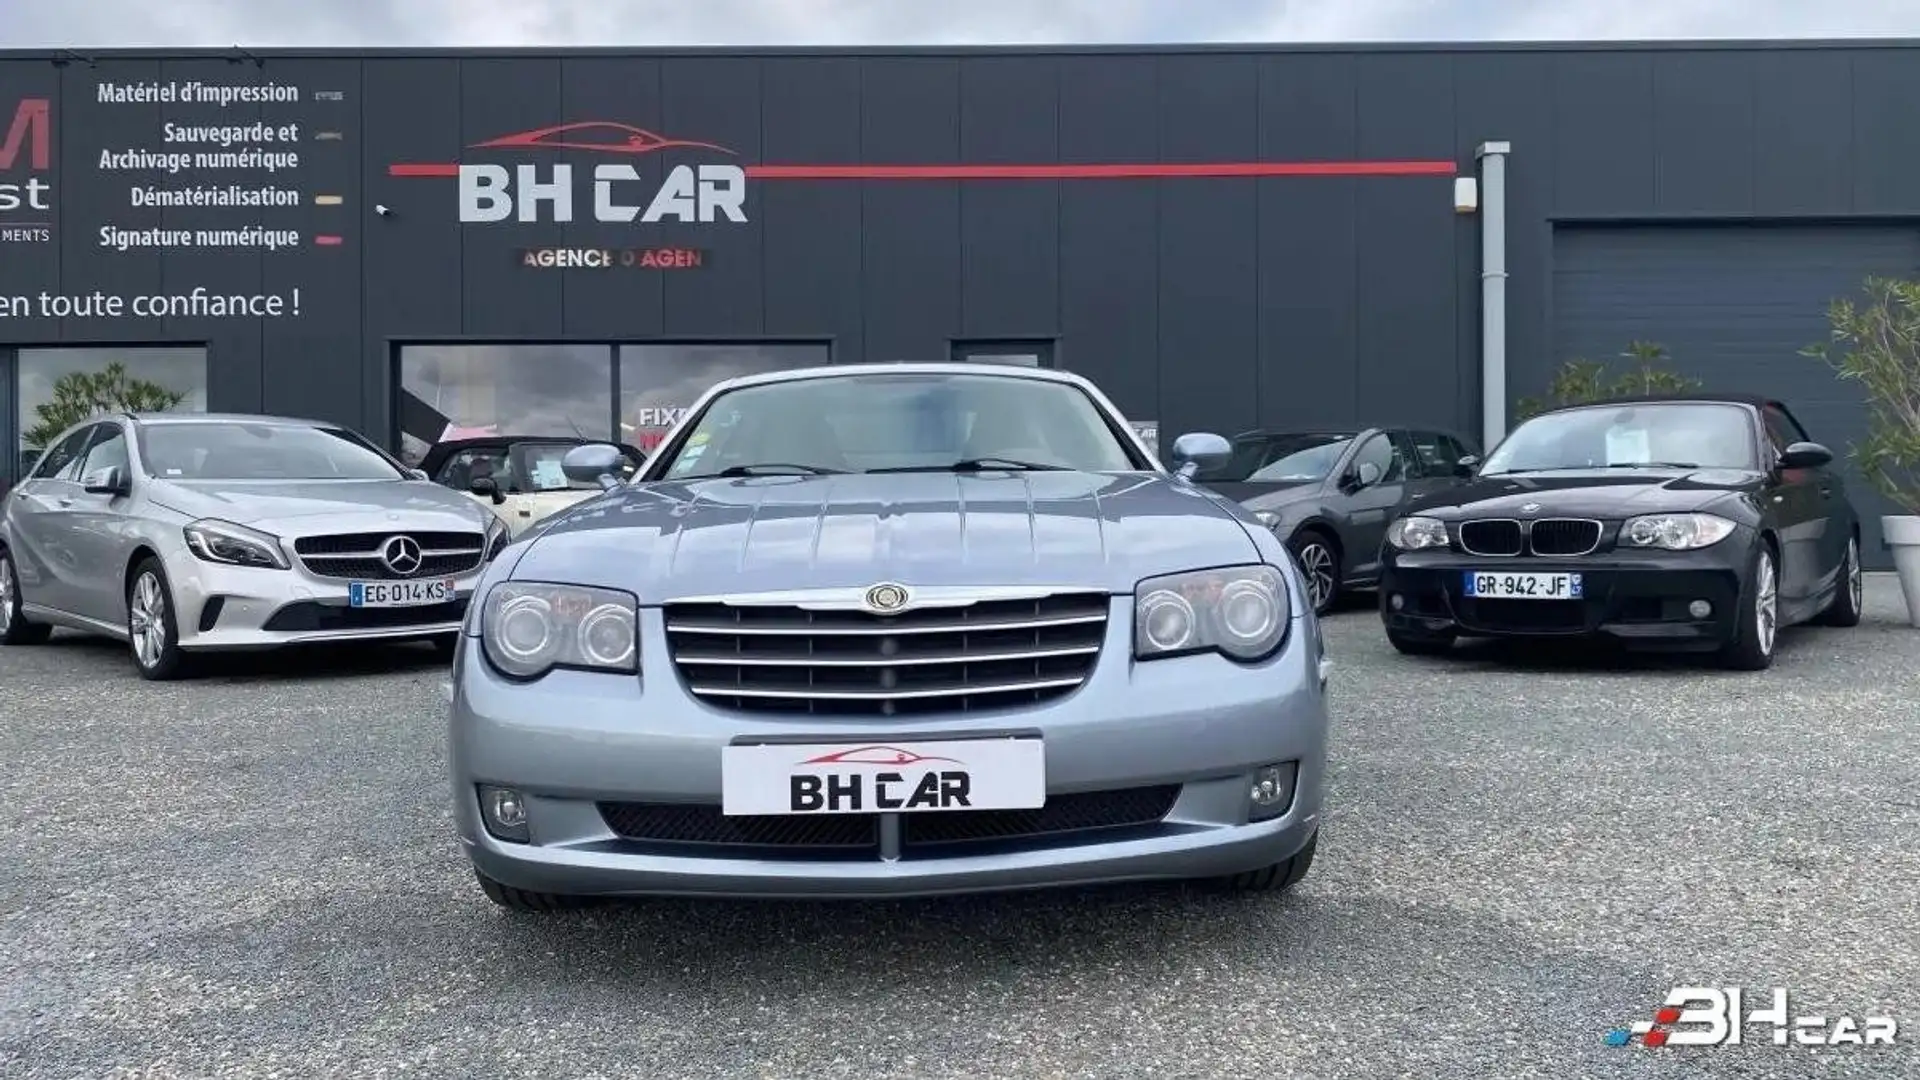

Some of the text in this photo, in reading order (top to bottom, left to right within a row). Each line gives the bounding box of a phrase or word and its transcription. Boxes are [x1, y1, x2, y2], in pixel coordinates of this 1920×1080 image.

[97, 82, 176, 103] Matériel
[164, 122, 298, 147] Sauvegarde et
[99, 149, 298, 173] Archivage numérique
[131, 186, 299, 207] Dématérialisation
[458, 164, 749, 223] BH CAR
[2, 229, 50, 242] MENTS
[99, 226, 299, 251] Signature numérique
[41, 291, 123, 317] toute
[132, 287, 283, 317] confiance
[293, 288, 300, 316] !
[1476, 575, 1568, 596] GR-942-JF
[790, 771, 972, 812] BH CAR
